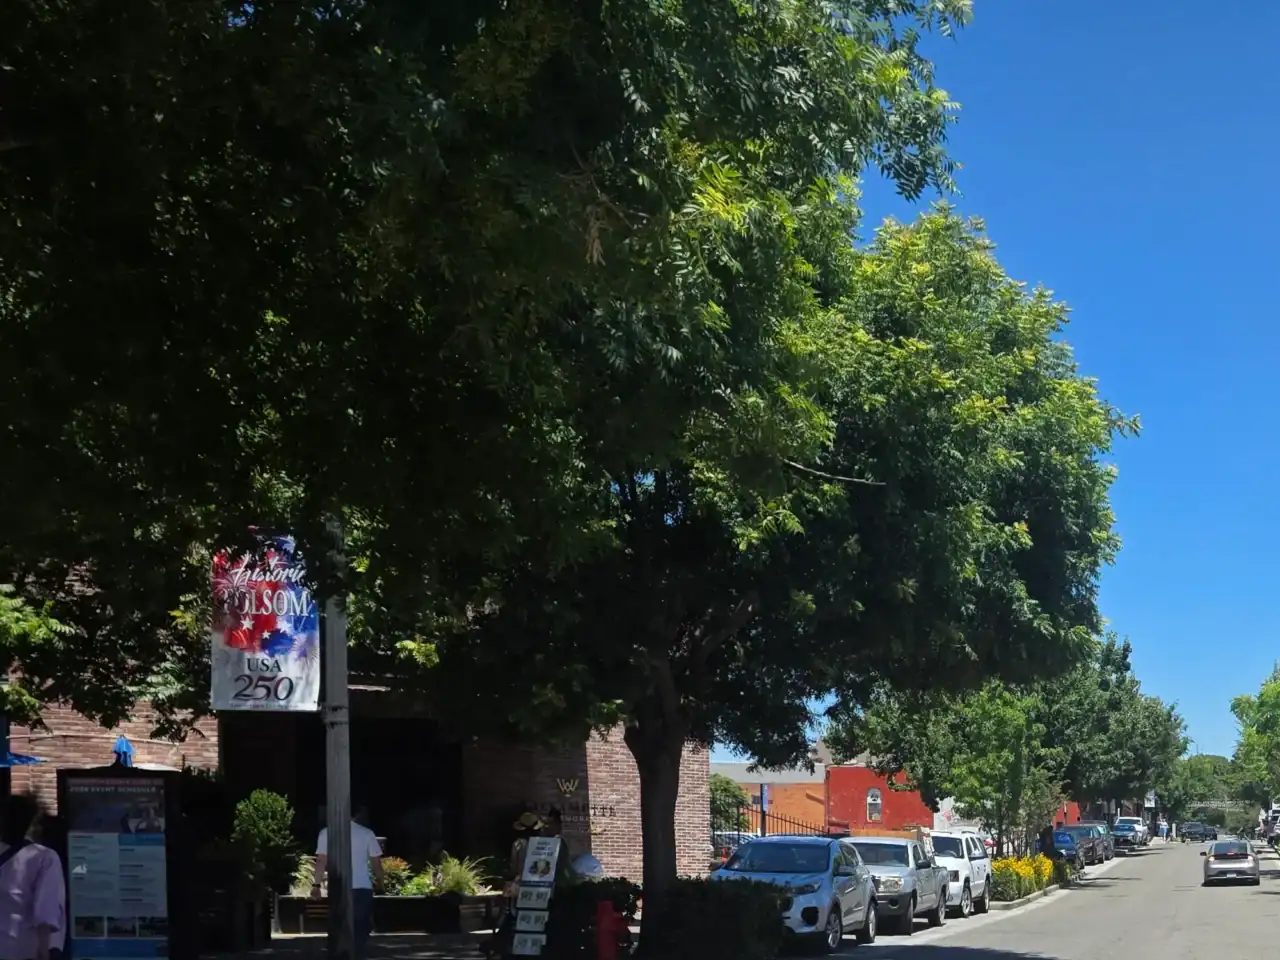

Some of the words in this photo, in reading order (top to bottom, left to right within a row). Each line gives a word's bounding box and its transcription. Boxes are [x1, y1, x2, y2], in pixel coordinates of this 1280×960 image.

[223, 589, 308, 616] FOLSOM
[245, 658, 282, 673] USA
[232, 674, 294, 700] 250
